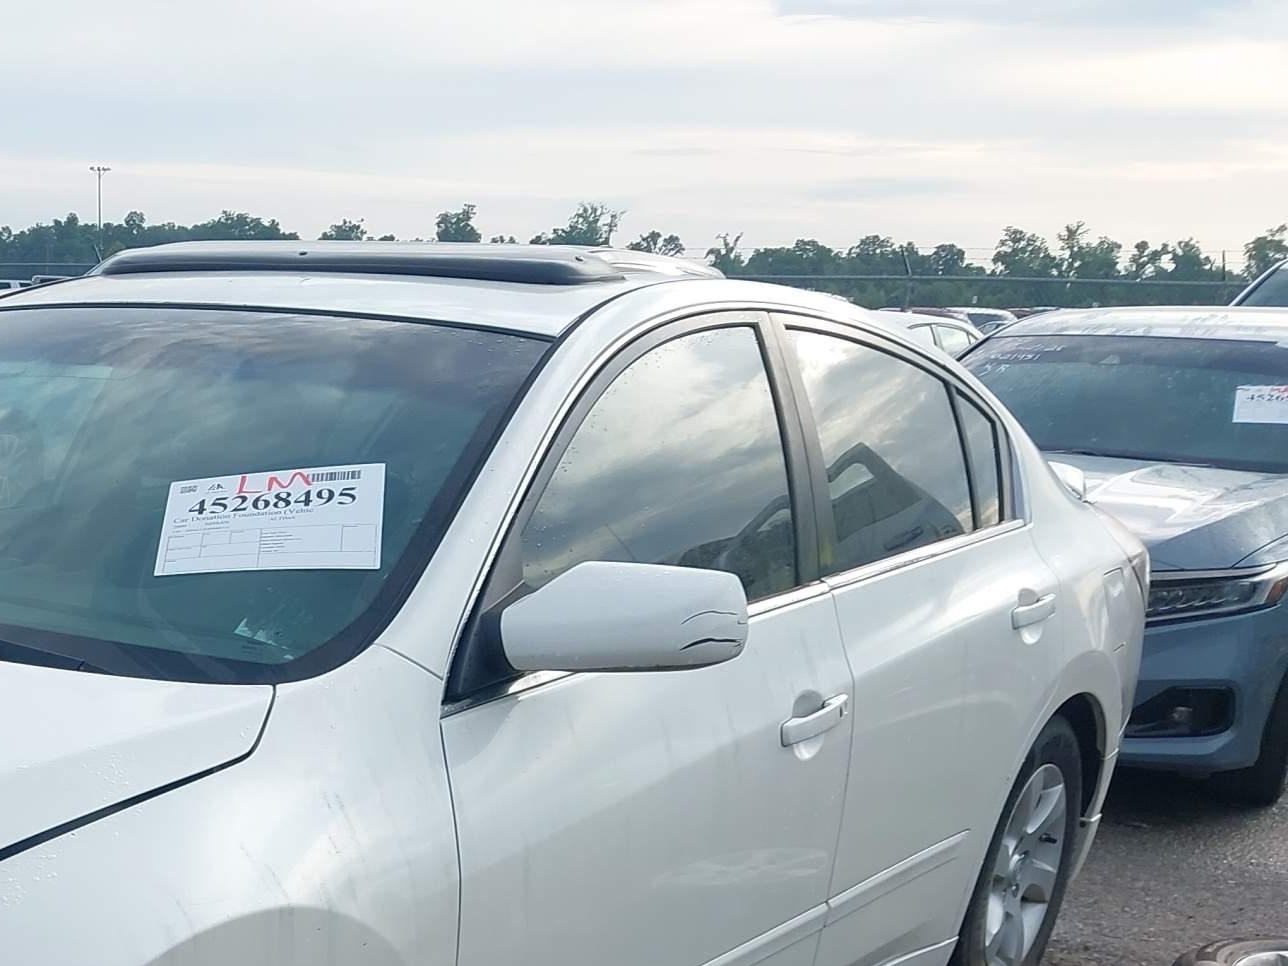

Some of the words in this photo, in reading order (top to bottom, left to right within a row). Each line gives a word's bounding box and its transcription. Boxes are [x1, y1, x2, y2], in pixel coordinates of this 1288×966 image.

[188, 486, 357, 515] 45268495
[173, 516, 190, 525] Car
[191, 512, 231, 522] Donation
[232, 508, 282, 519] Foundation
